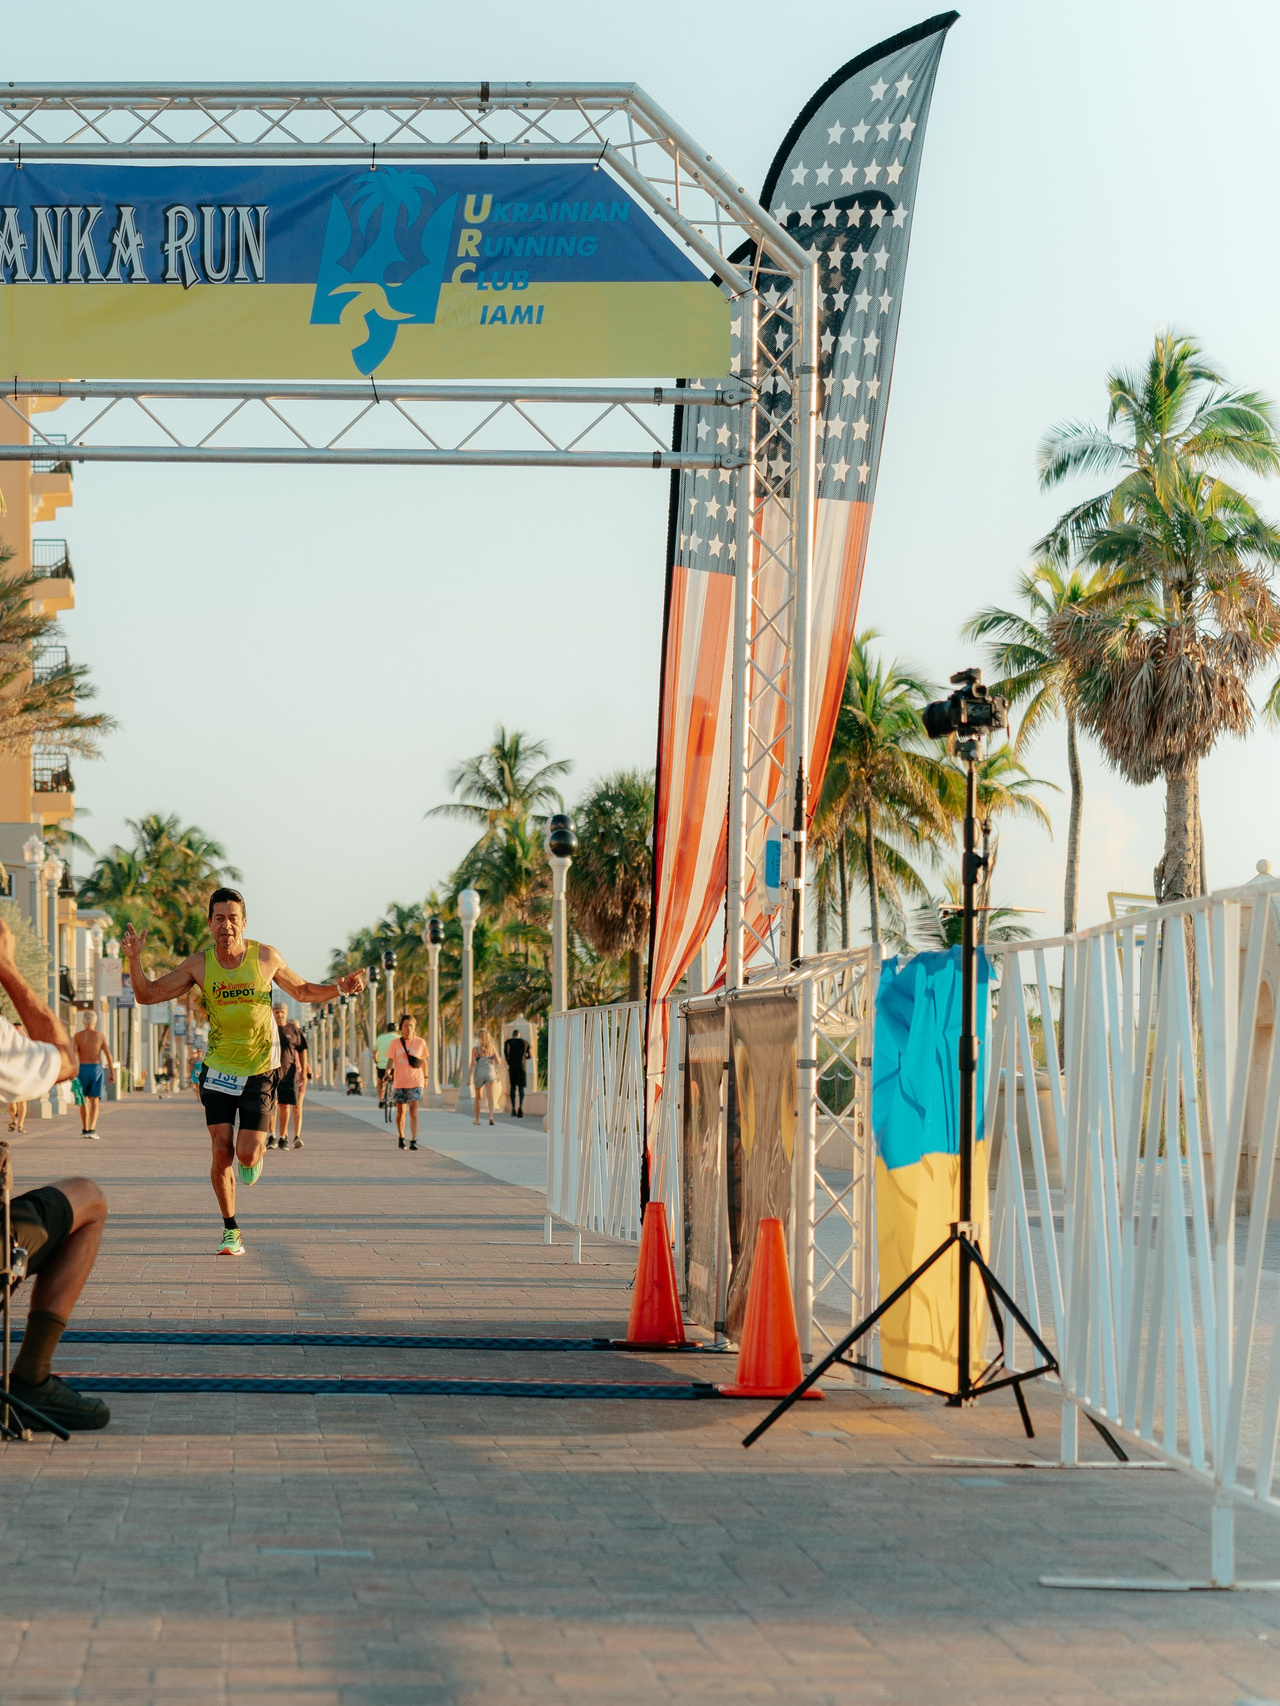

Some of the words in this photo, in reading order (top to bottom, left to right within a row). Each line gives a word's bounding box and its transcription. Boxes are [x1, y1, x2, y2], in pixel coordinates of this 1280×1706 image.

[463, 193, 630, 224] UKRAINIAN
[163, 203, 268, 290] RUN
[457, 228, 599, 258] RUNNING
[451, 262, 530, 292] CLUB
[222, 988, 256, 999] DEPOT
[238, 996, 254, 1004] Team
